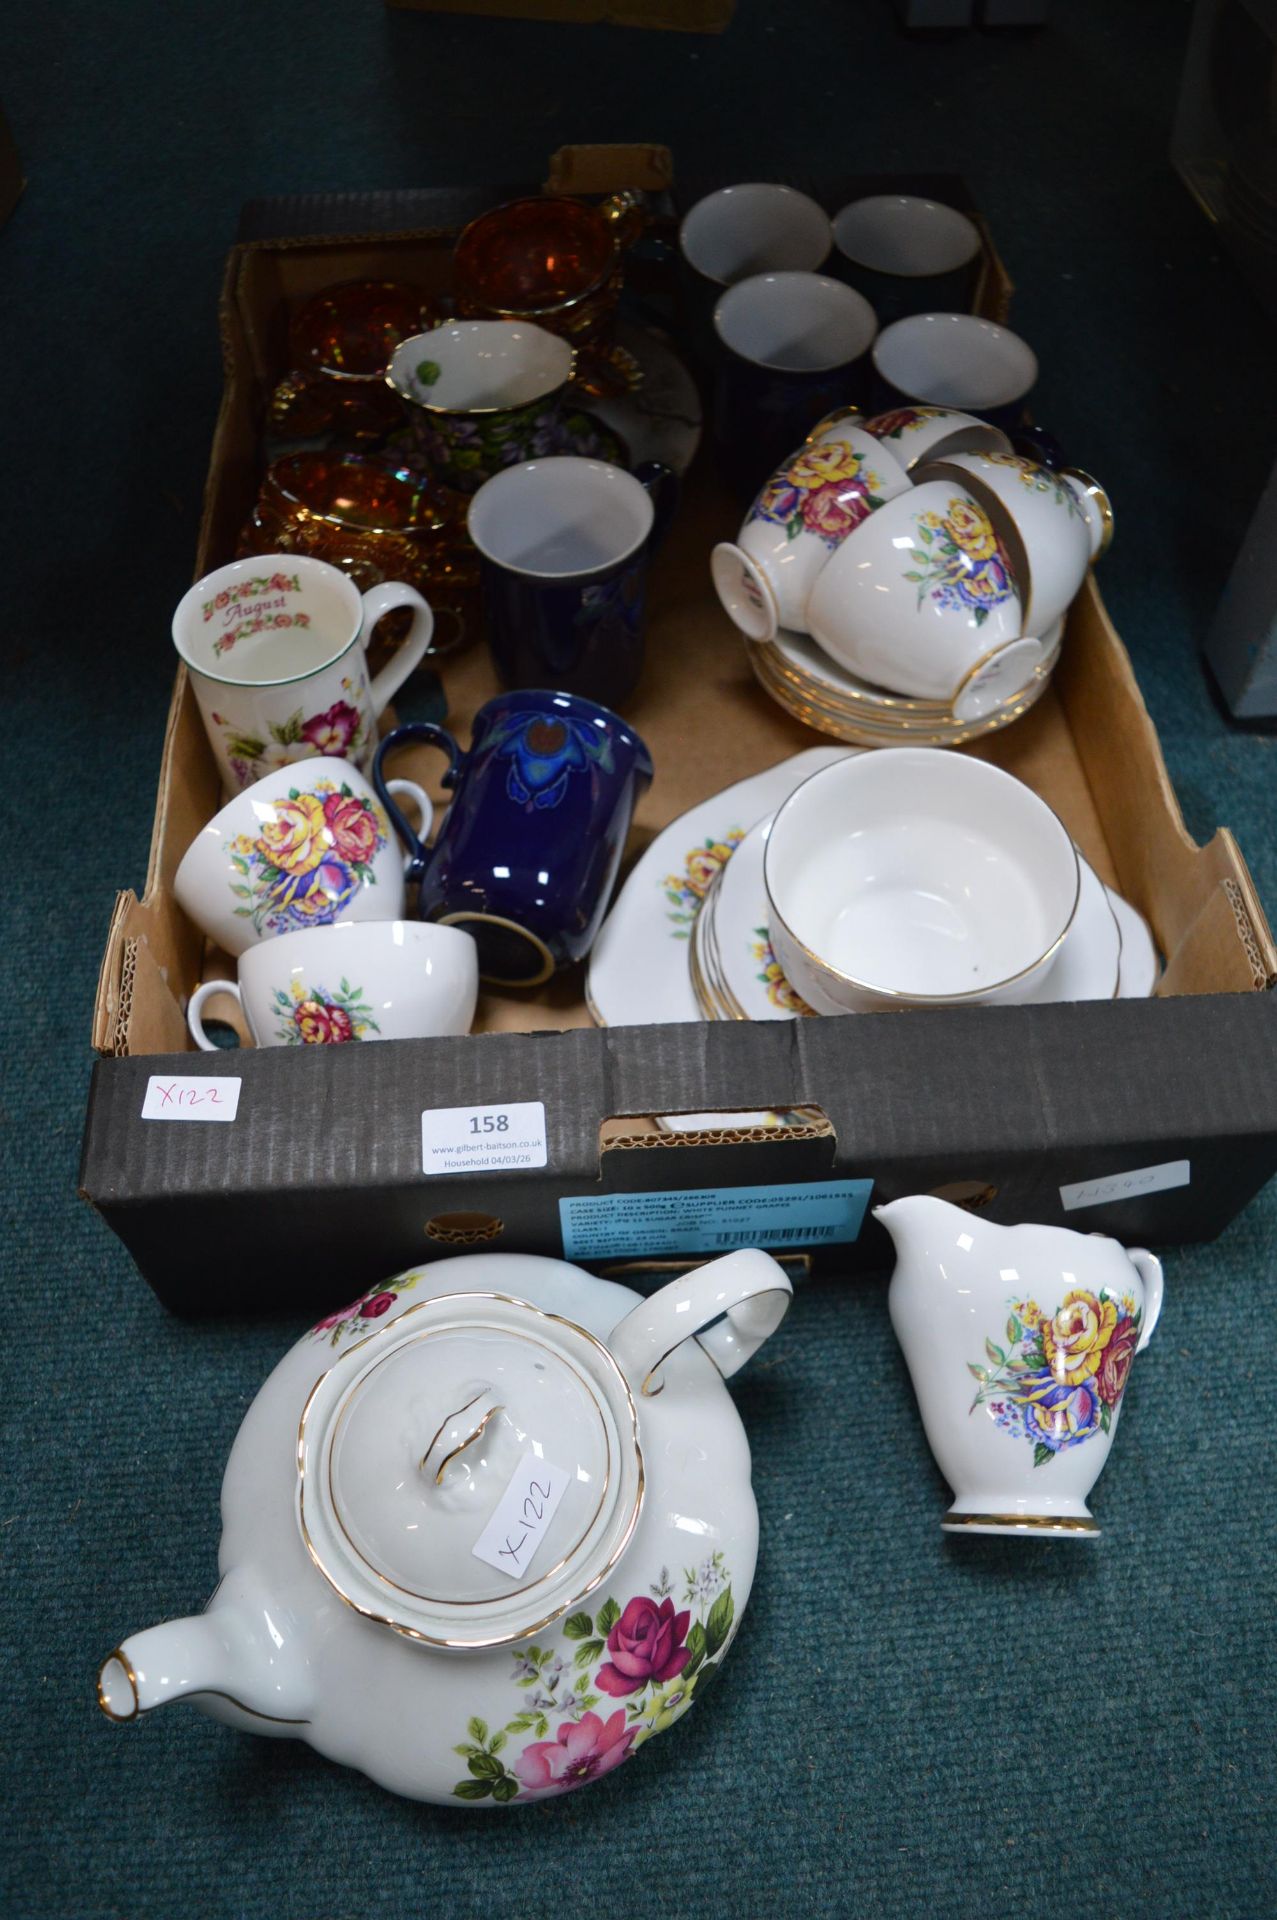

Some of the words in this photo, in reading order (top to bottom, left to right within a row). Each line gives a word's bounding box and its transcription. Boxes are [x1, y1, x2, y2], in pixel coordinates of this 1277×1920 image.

[222, 595, 287, 627] August
[155, 1083, 223, 1107] X122
[468, 1115, 510, 1134] 158
[431, 1139, 543, 1155] www.gilbert-baitson.co.uk
[443, 1156, 490, 1168] Household
[491, 1154, 531, 1167] 04/03/26
[569, 1199, 613, 1208] PRODUCT
[686, 1199, 736, 1207] SUPPLIER
[570, 1213, 614, 1221] PRODUCT
[498, 1480, 551, 1565] X122
